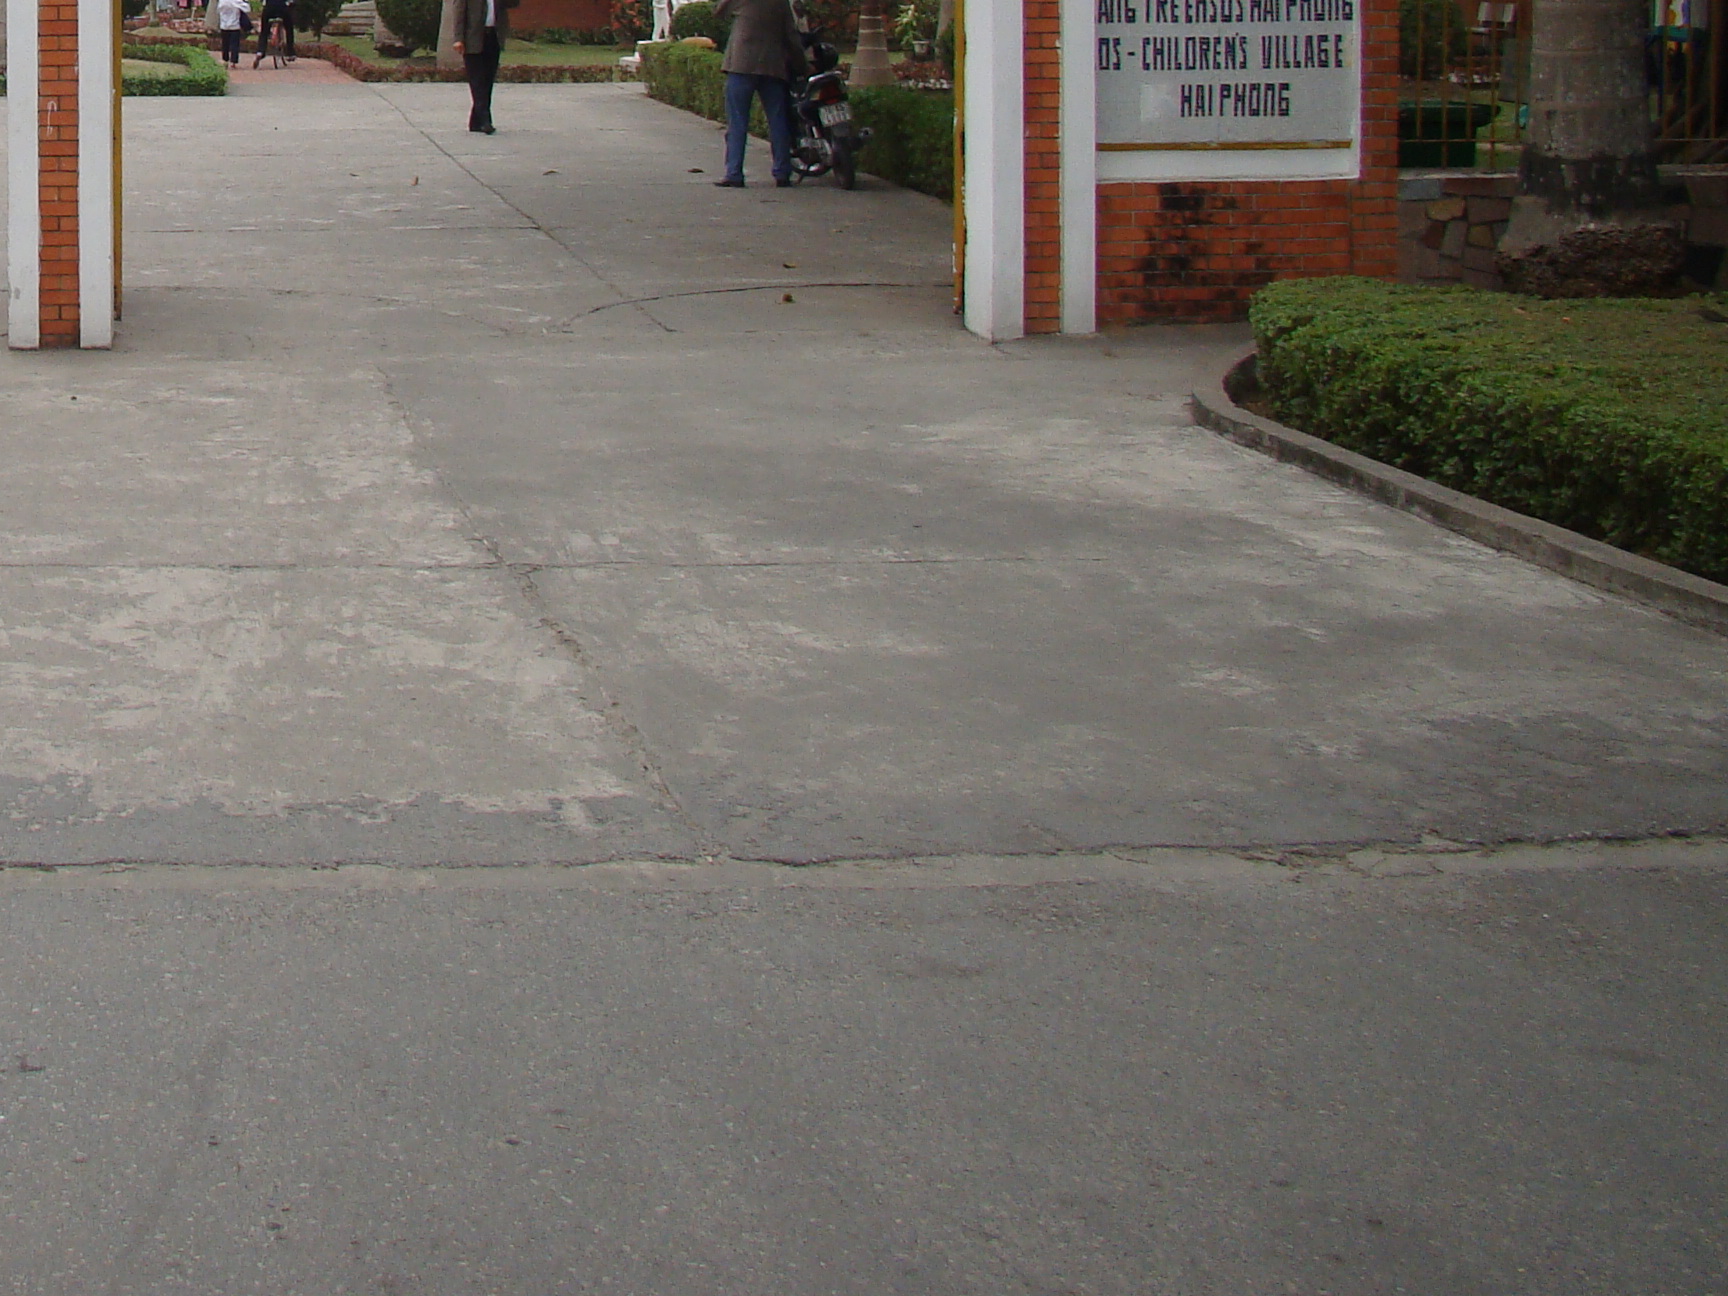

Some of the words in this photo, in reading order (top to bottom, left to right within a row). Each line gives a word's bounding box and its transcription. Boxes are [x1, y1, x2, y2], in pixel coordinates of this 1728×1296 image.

[1098, 37, 1121, 71] OS
[1261, 34, 1343, 69] VILLAGE
[1180, 84, 1213, 117] HAI
[1219, 82, 1290, 117] PHONG
